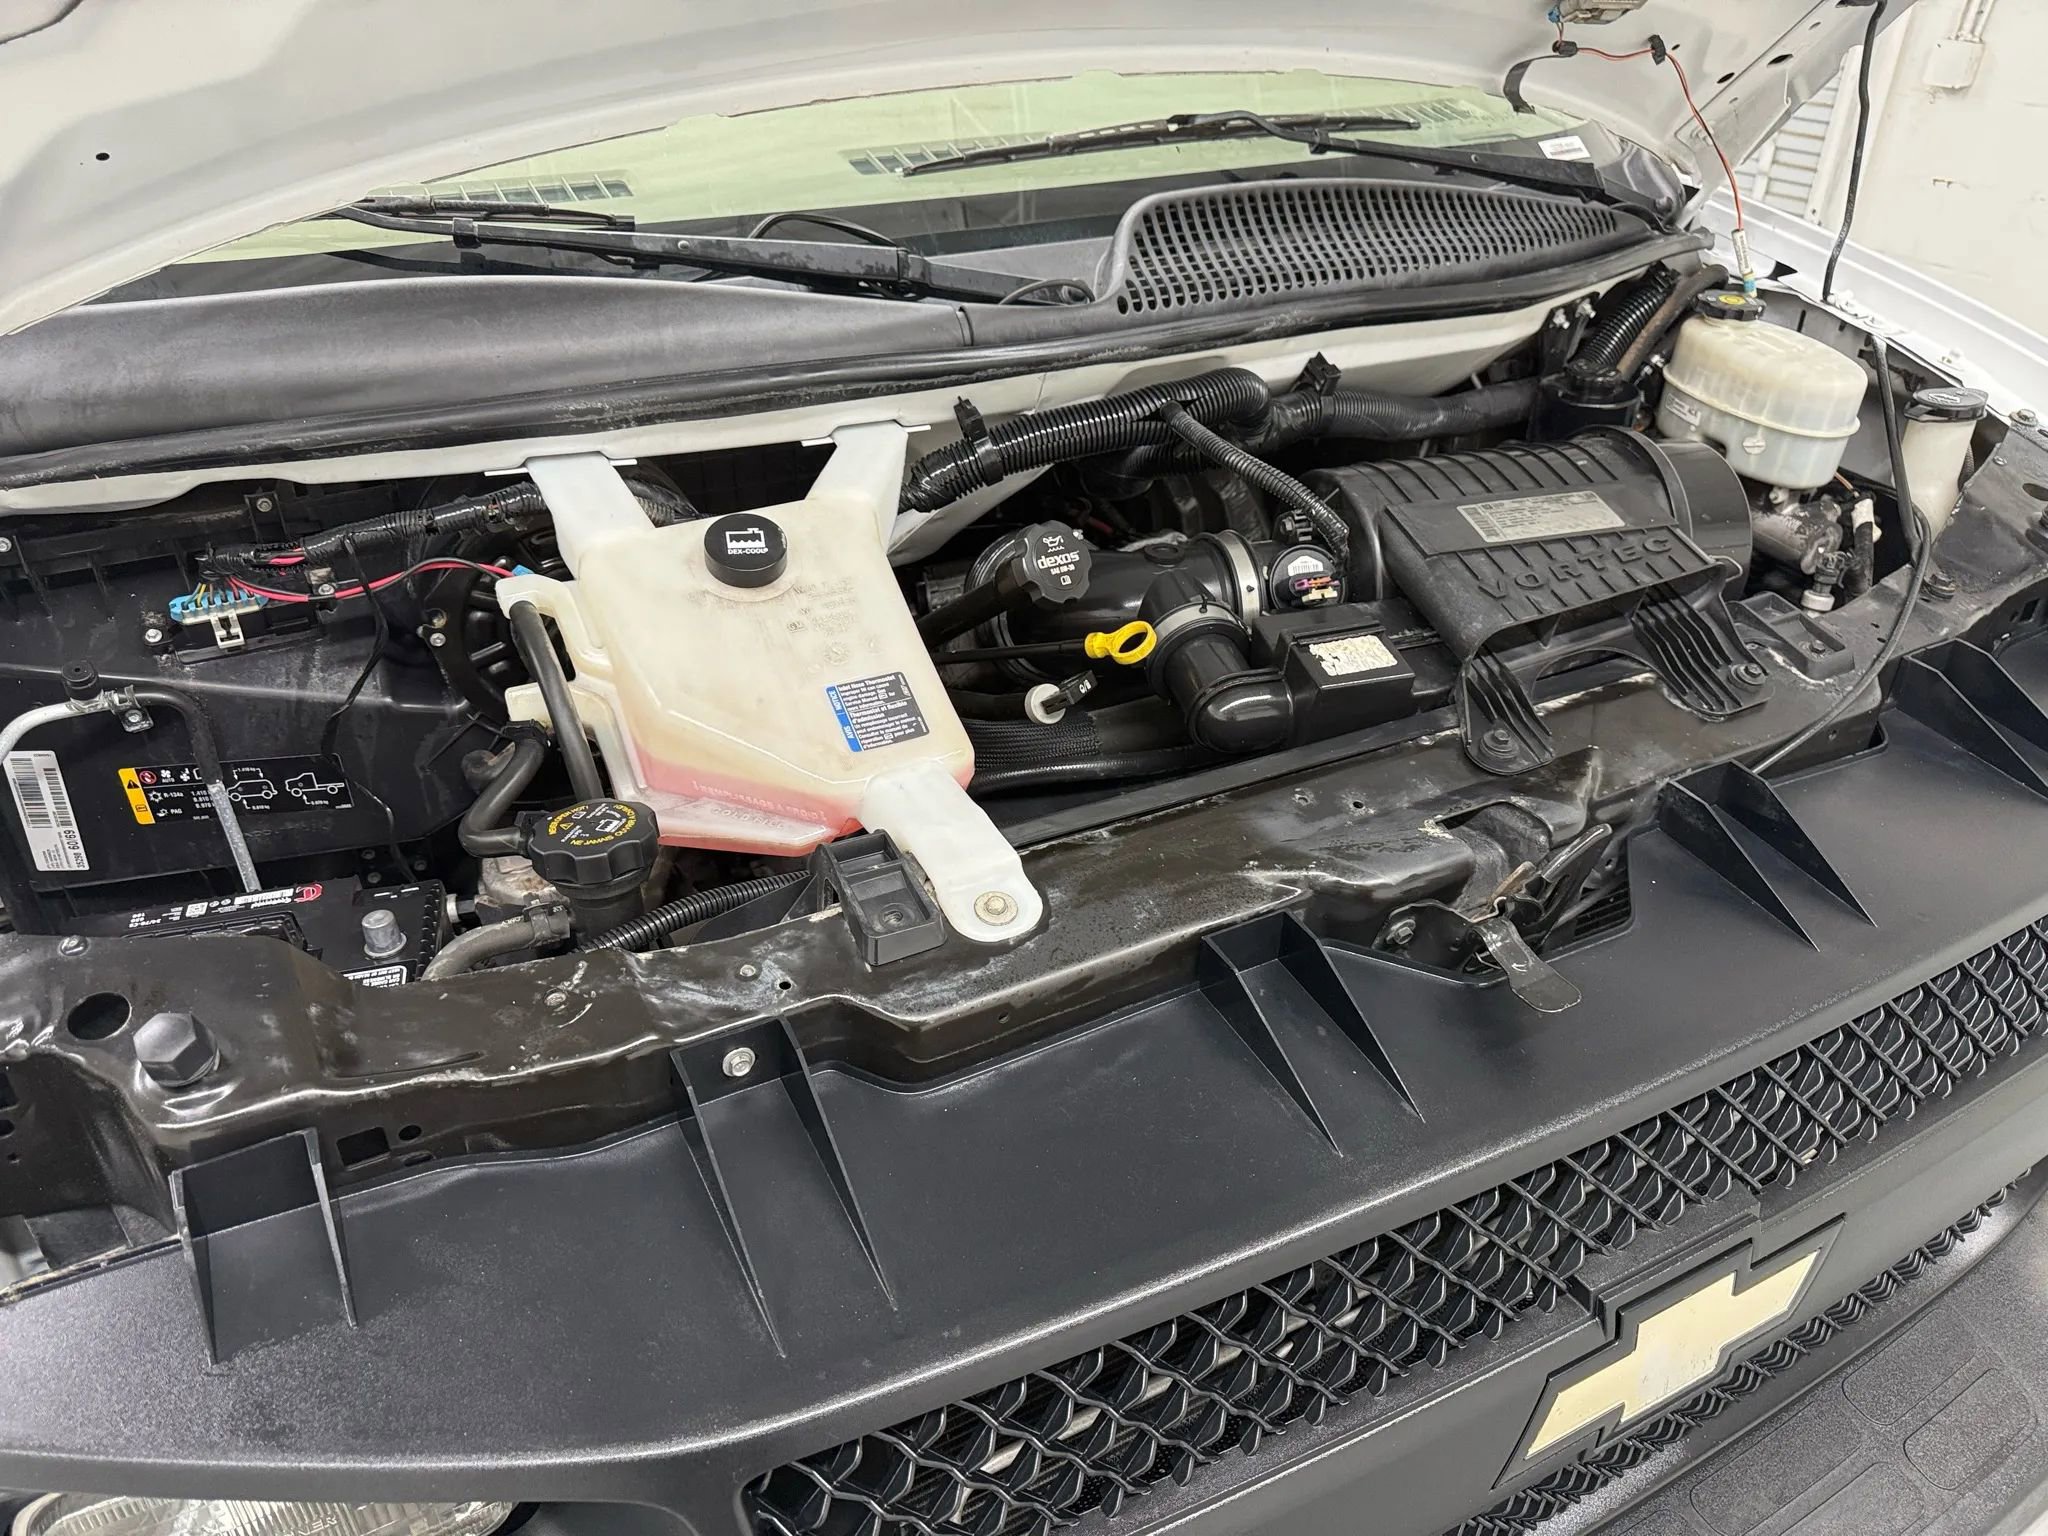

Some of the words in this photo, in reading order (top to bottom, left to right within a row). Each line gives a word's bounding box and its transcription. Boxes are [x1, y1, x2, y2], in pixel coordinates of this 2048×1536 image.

[1037, 550, 1080, 569] dexos
[1478, 536, 1672, 600] VORTEC
[864, 675, 895, 685] Thermostat
[828, 690, 842, 710] NOTICE
[849, 707, 880, 717] Thermostat
[843, 726, 854, 739] AVIS
[711, 807, 750, 821] COLD
[64, 829, 80, 851] 60/69
[583, 835, 614, 845] JAMAIS
